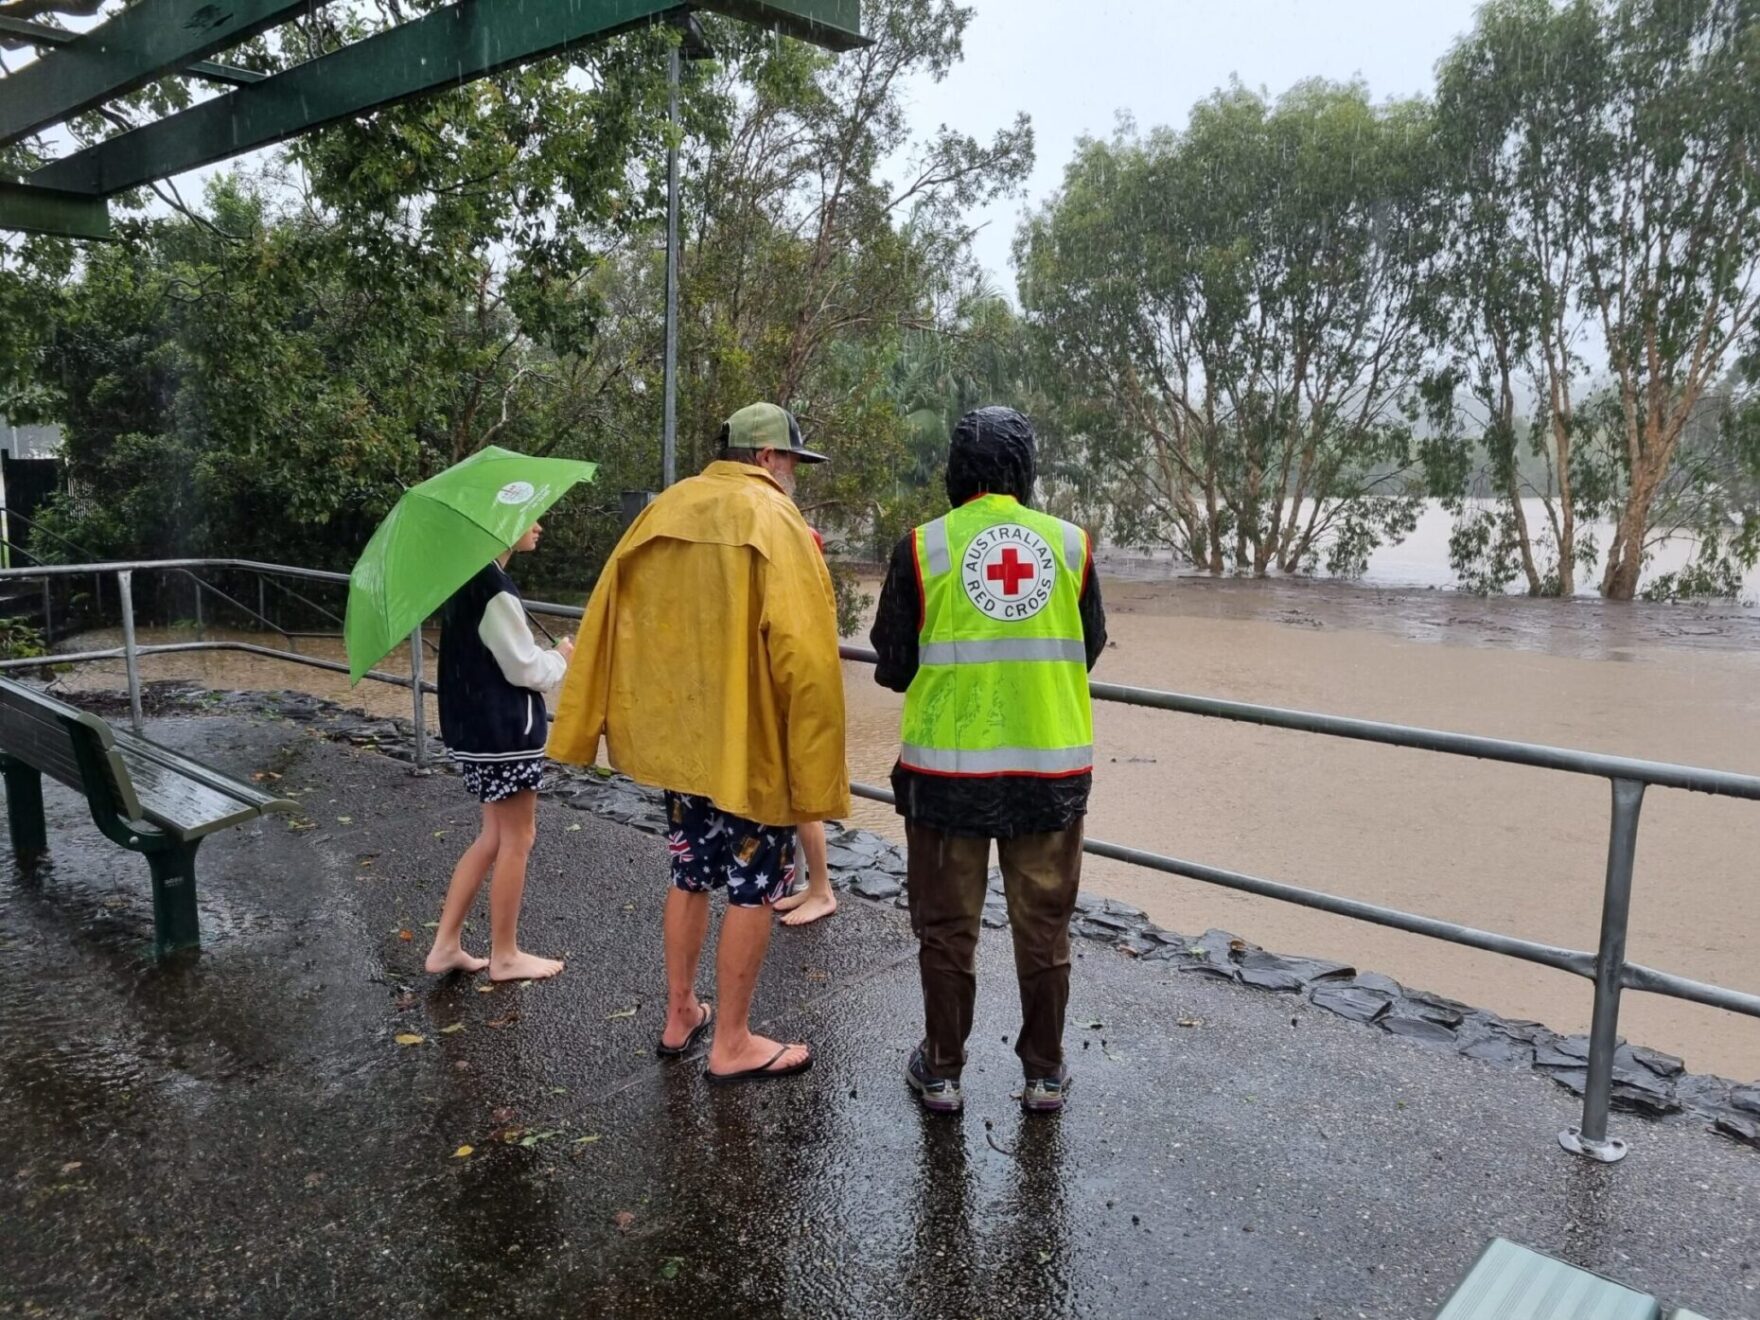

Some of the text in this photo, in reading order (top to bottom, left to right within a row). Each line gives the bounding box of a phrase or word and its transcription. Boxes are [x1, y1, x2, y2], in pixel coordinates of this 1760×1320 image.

[966, 527, 1053, 572] AUSTRALIAN
[967, 578, 1052, 618] RED CROSS
